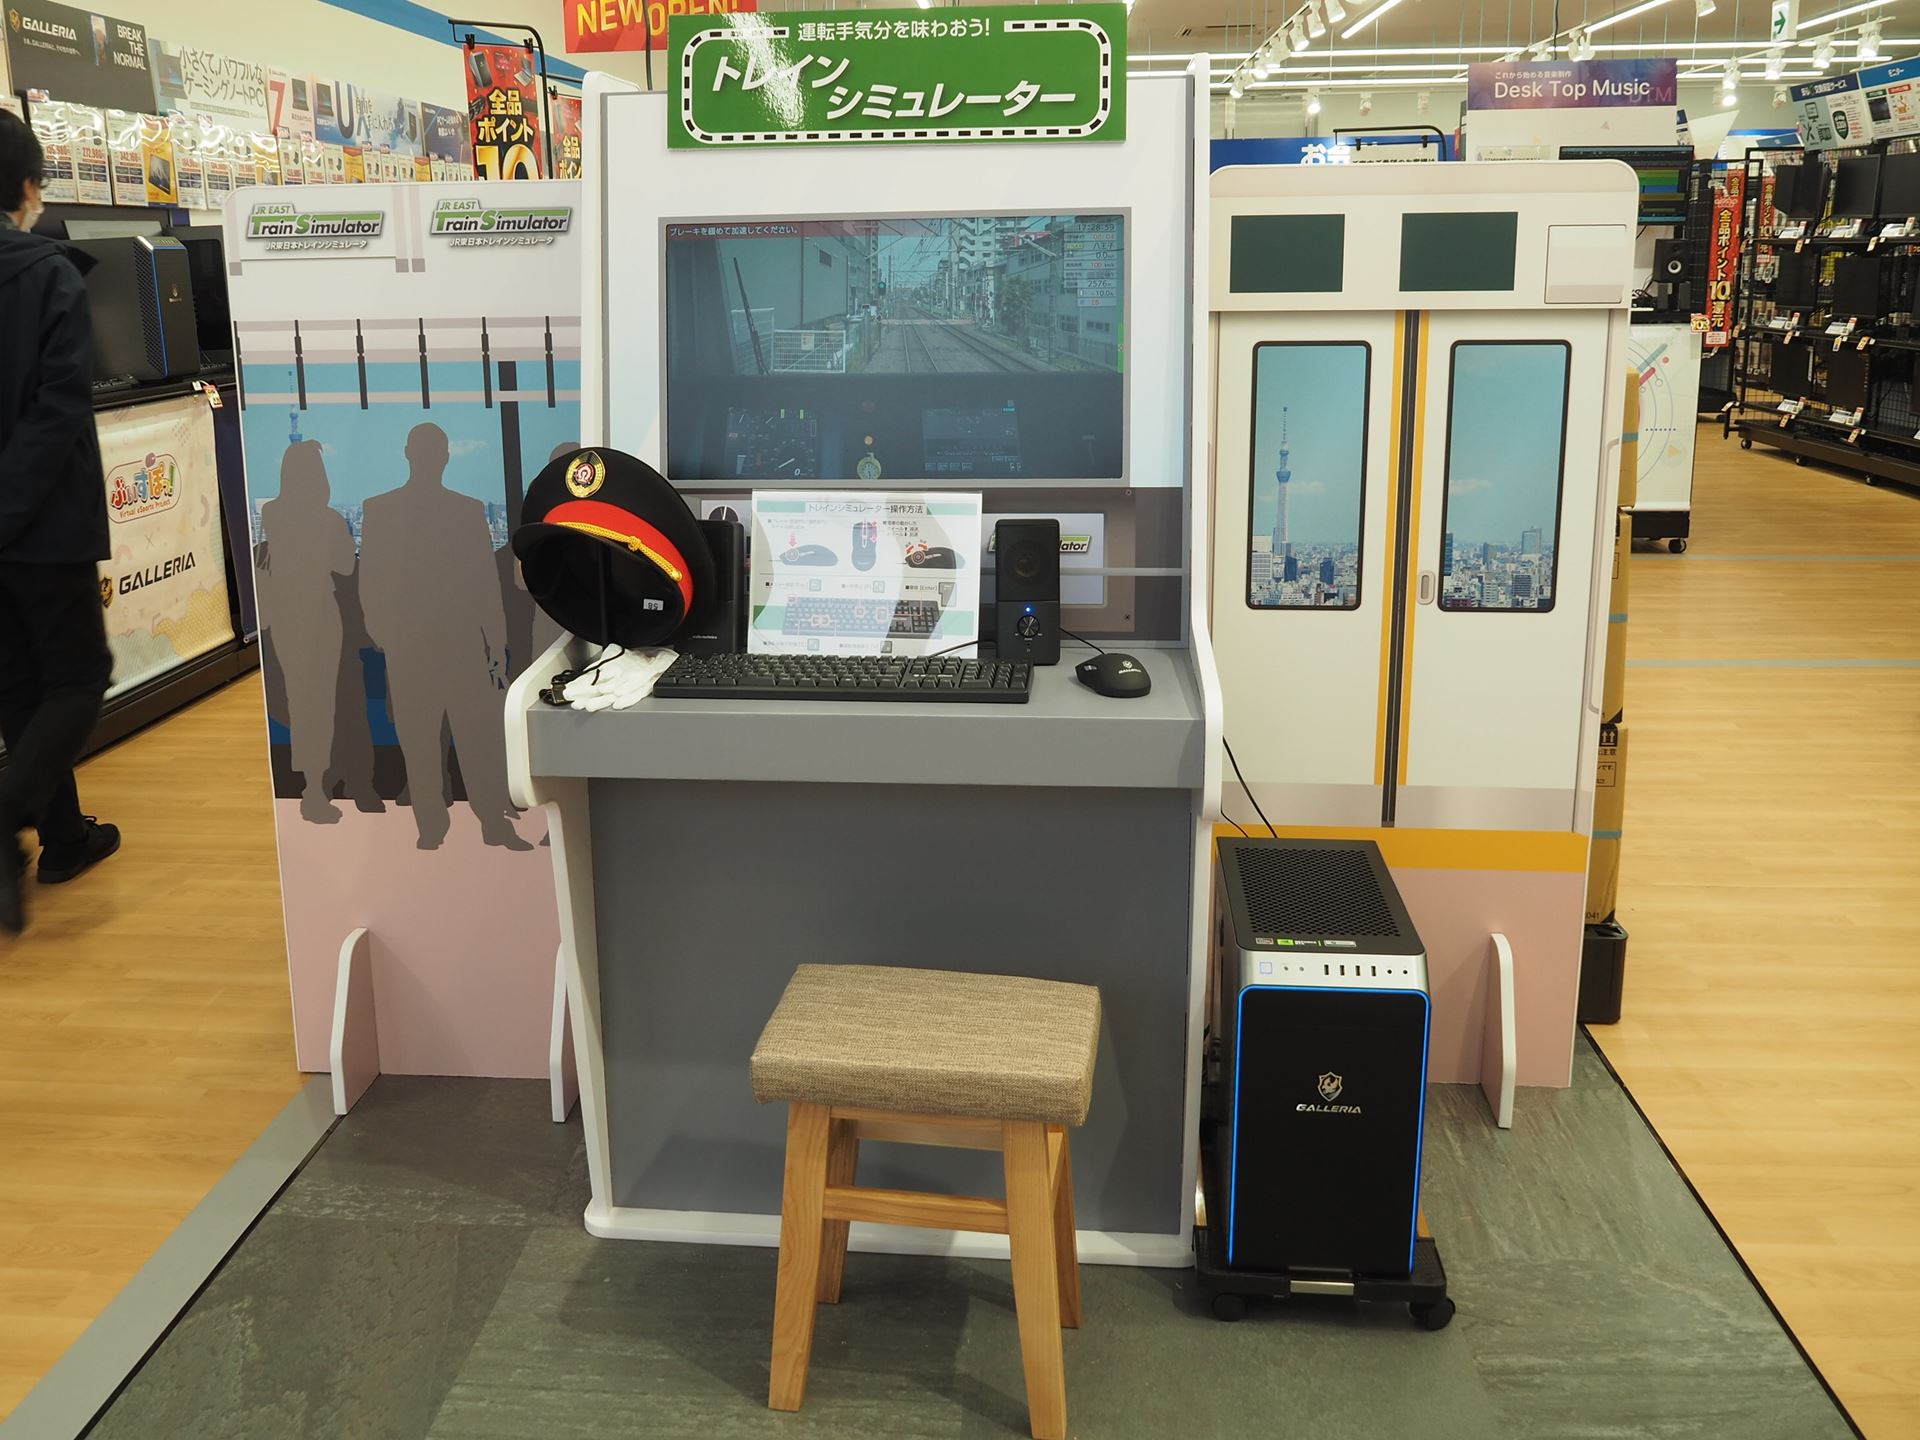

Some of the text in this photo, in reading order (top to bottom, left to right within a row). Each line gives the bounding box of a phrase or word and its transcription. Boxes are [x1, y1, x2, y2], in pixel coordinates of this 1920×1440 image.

[577, 0, 644, 36] NEW
[22, 17, 77, 40] GALLERIA
[117, 25, 143, 42] BREAK
[129, 41, 144, 56] THE
[113, 52, 147, 70] NORMAL
[712, 54, 850, 91] トレイン
[1495, 79, 1650, 100] Desk Top Music
[489, 89, 522, 115] 全品
[827, 80, 1077, 119] シミュレーター
[478, 117, 534, 142] ポイント
[563, 135, 581, 159] 全品
[475, 143, 540, 180] 10
[255, 205, 290, 214] JR EAST
[440, 201, 476, 210] JR EAST
[266, 239, 368, 251] JR東日本トレインシミュレータ
[450, 236, 553, 247] JR東日本トレインシミュレータ
[119, 506, 136, 518] Virtual
[808, 503, 924, 514] トレインシミュレーター操作方法
[119, 552, 196, 595] GALLERIA
[1296, 1103, 1362, 1114] GALLERIA
